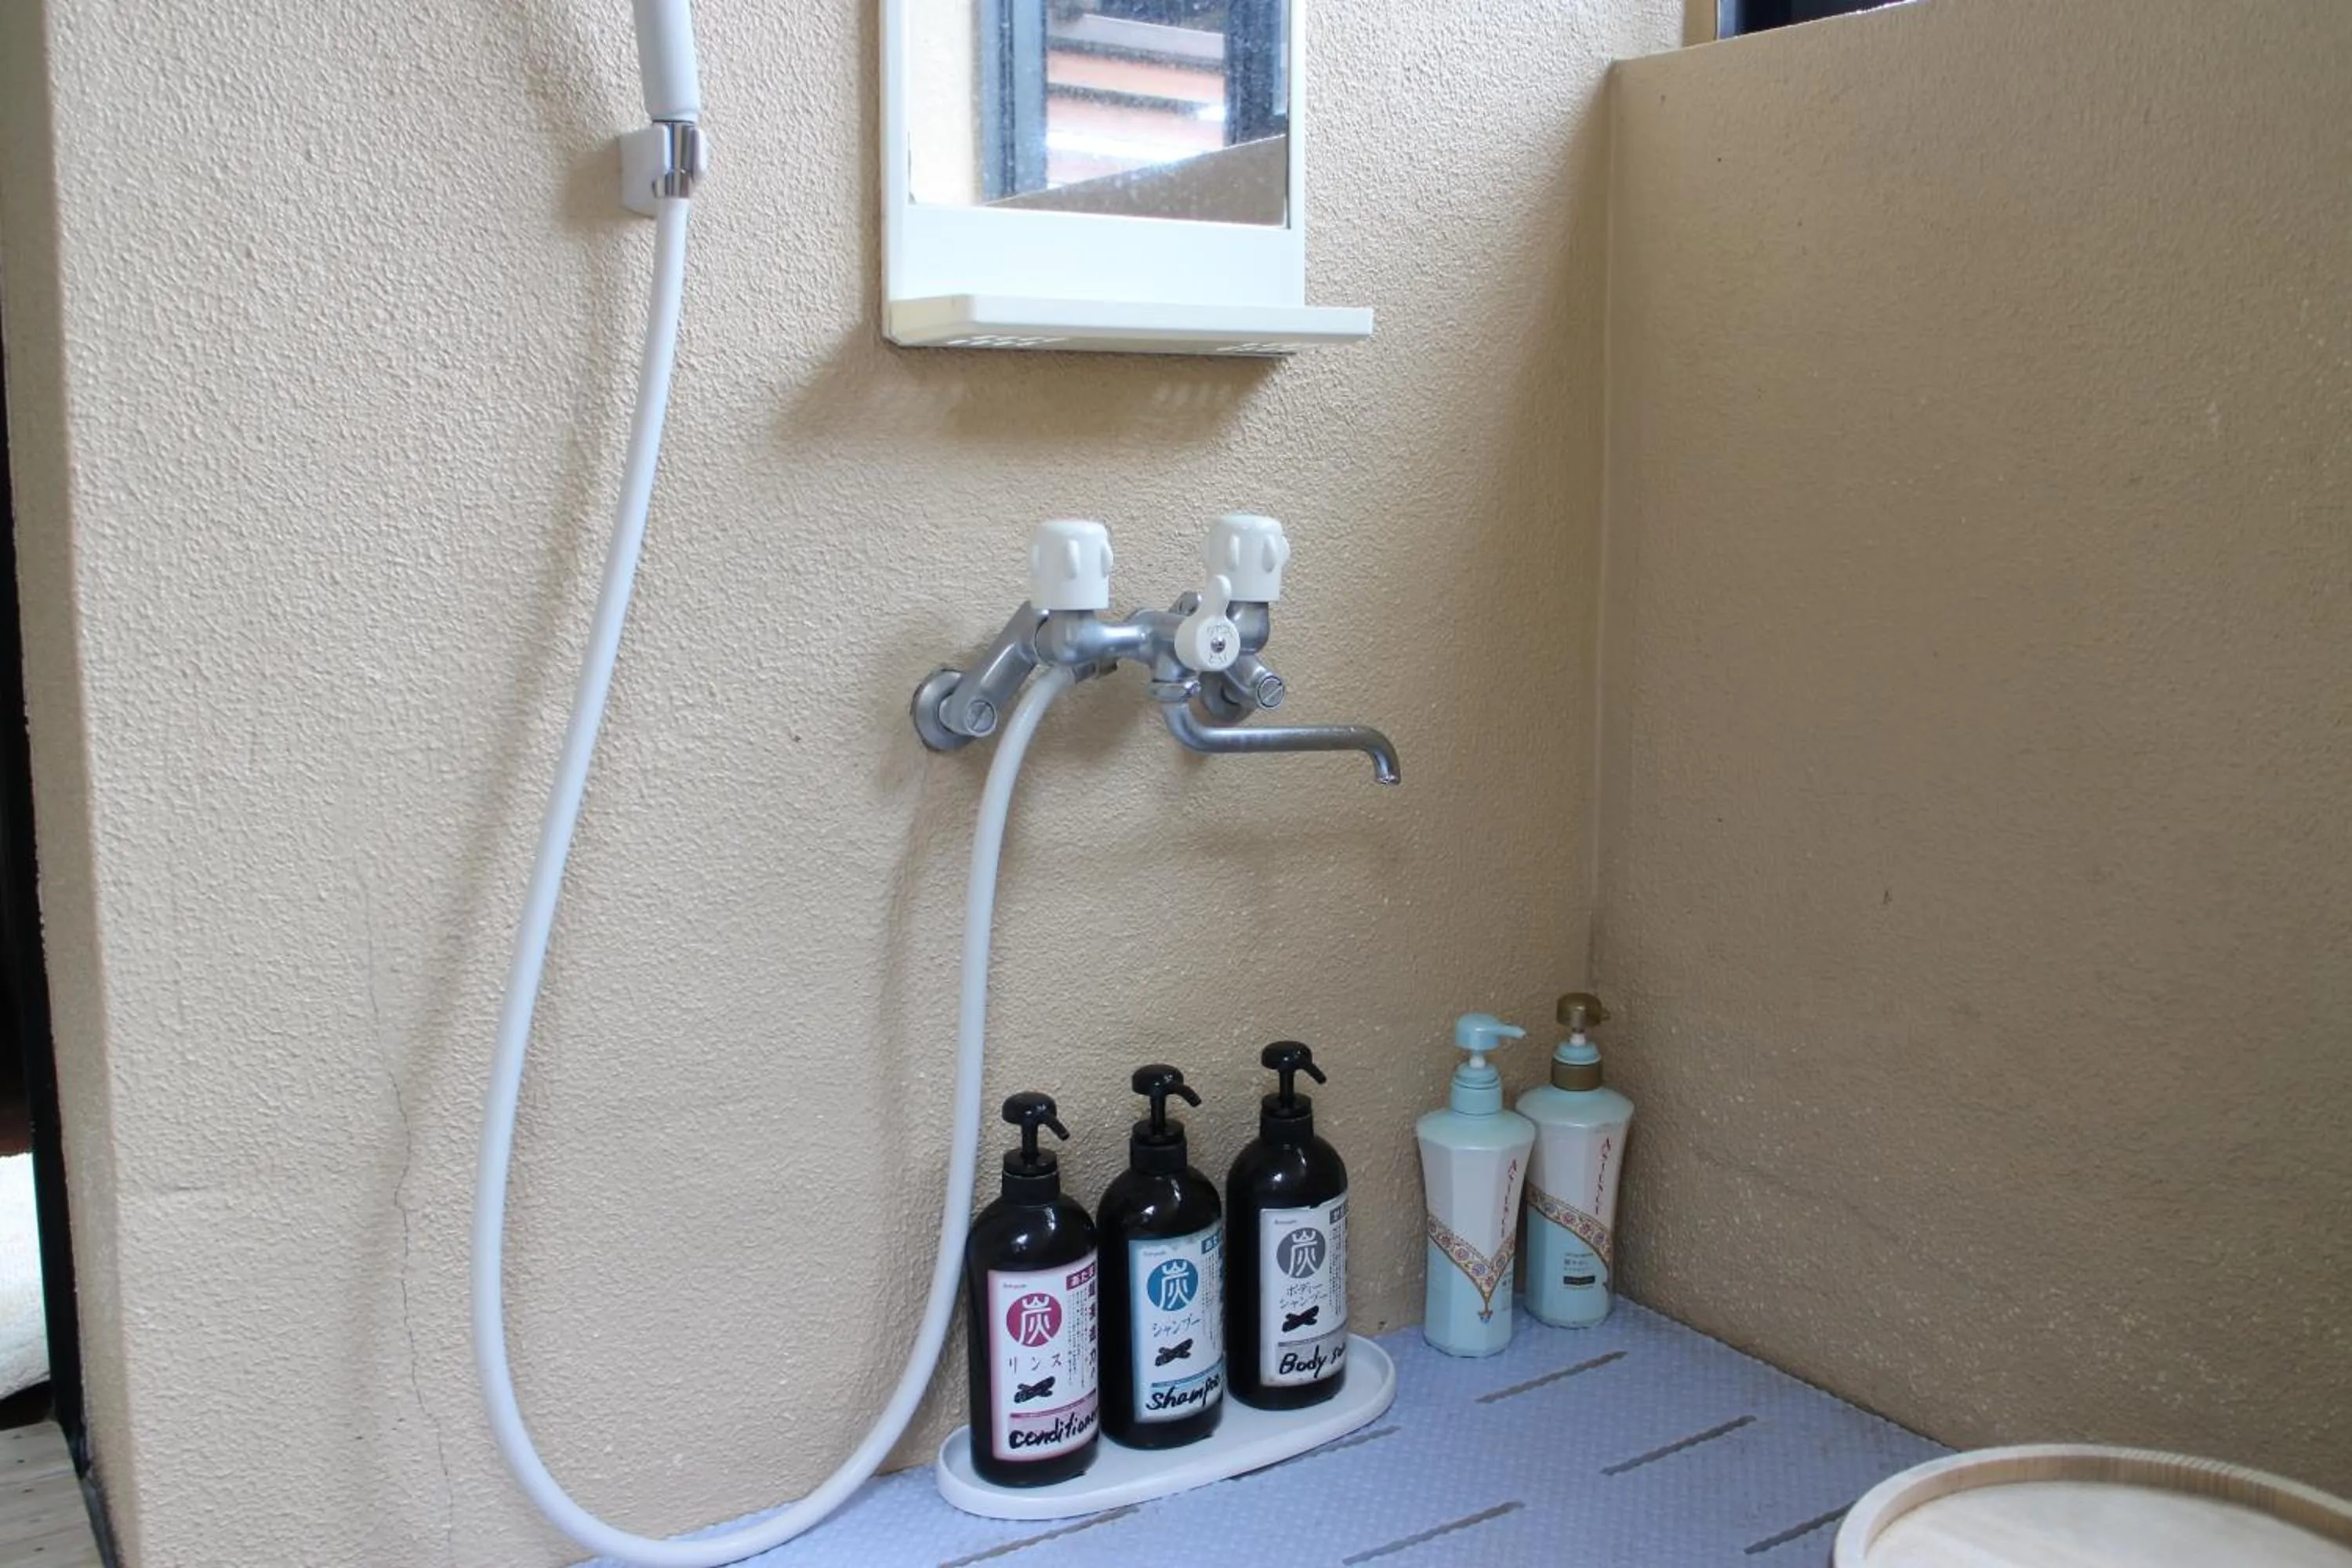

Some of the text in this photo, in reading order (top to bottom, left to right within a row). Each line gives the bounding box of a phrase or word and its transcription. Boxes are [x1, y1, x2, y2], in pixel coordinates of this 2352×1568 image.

[1288, 1230, 1318, 1276] 炭
[1160, 1261, 1190, 1309] 炭
[1020, 1295, 1053, 1345] 炭
[1153, 1313, 1202, 1338] シャンプー
[1009, 1352, 1064, 1374] リンス
[1279, 1345, 1327, 1378] Body
